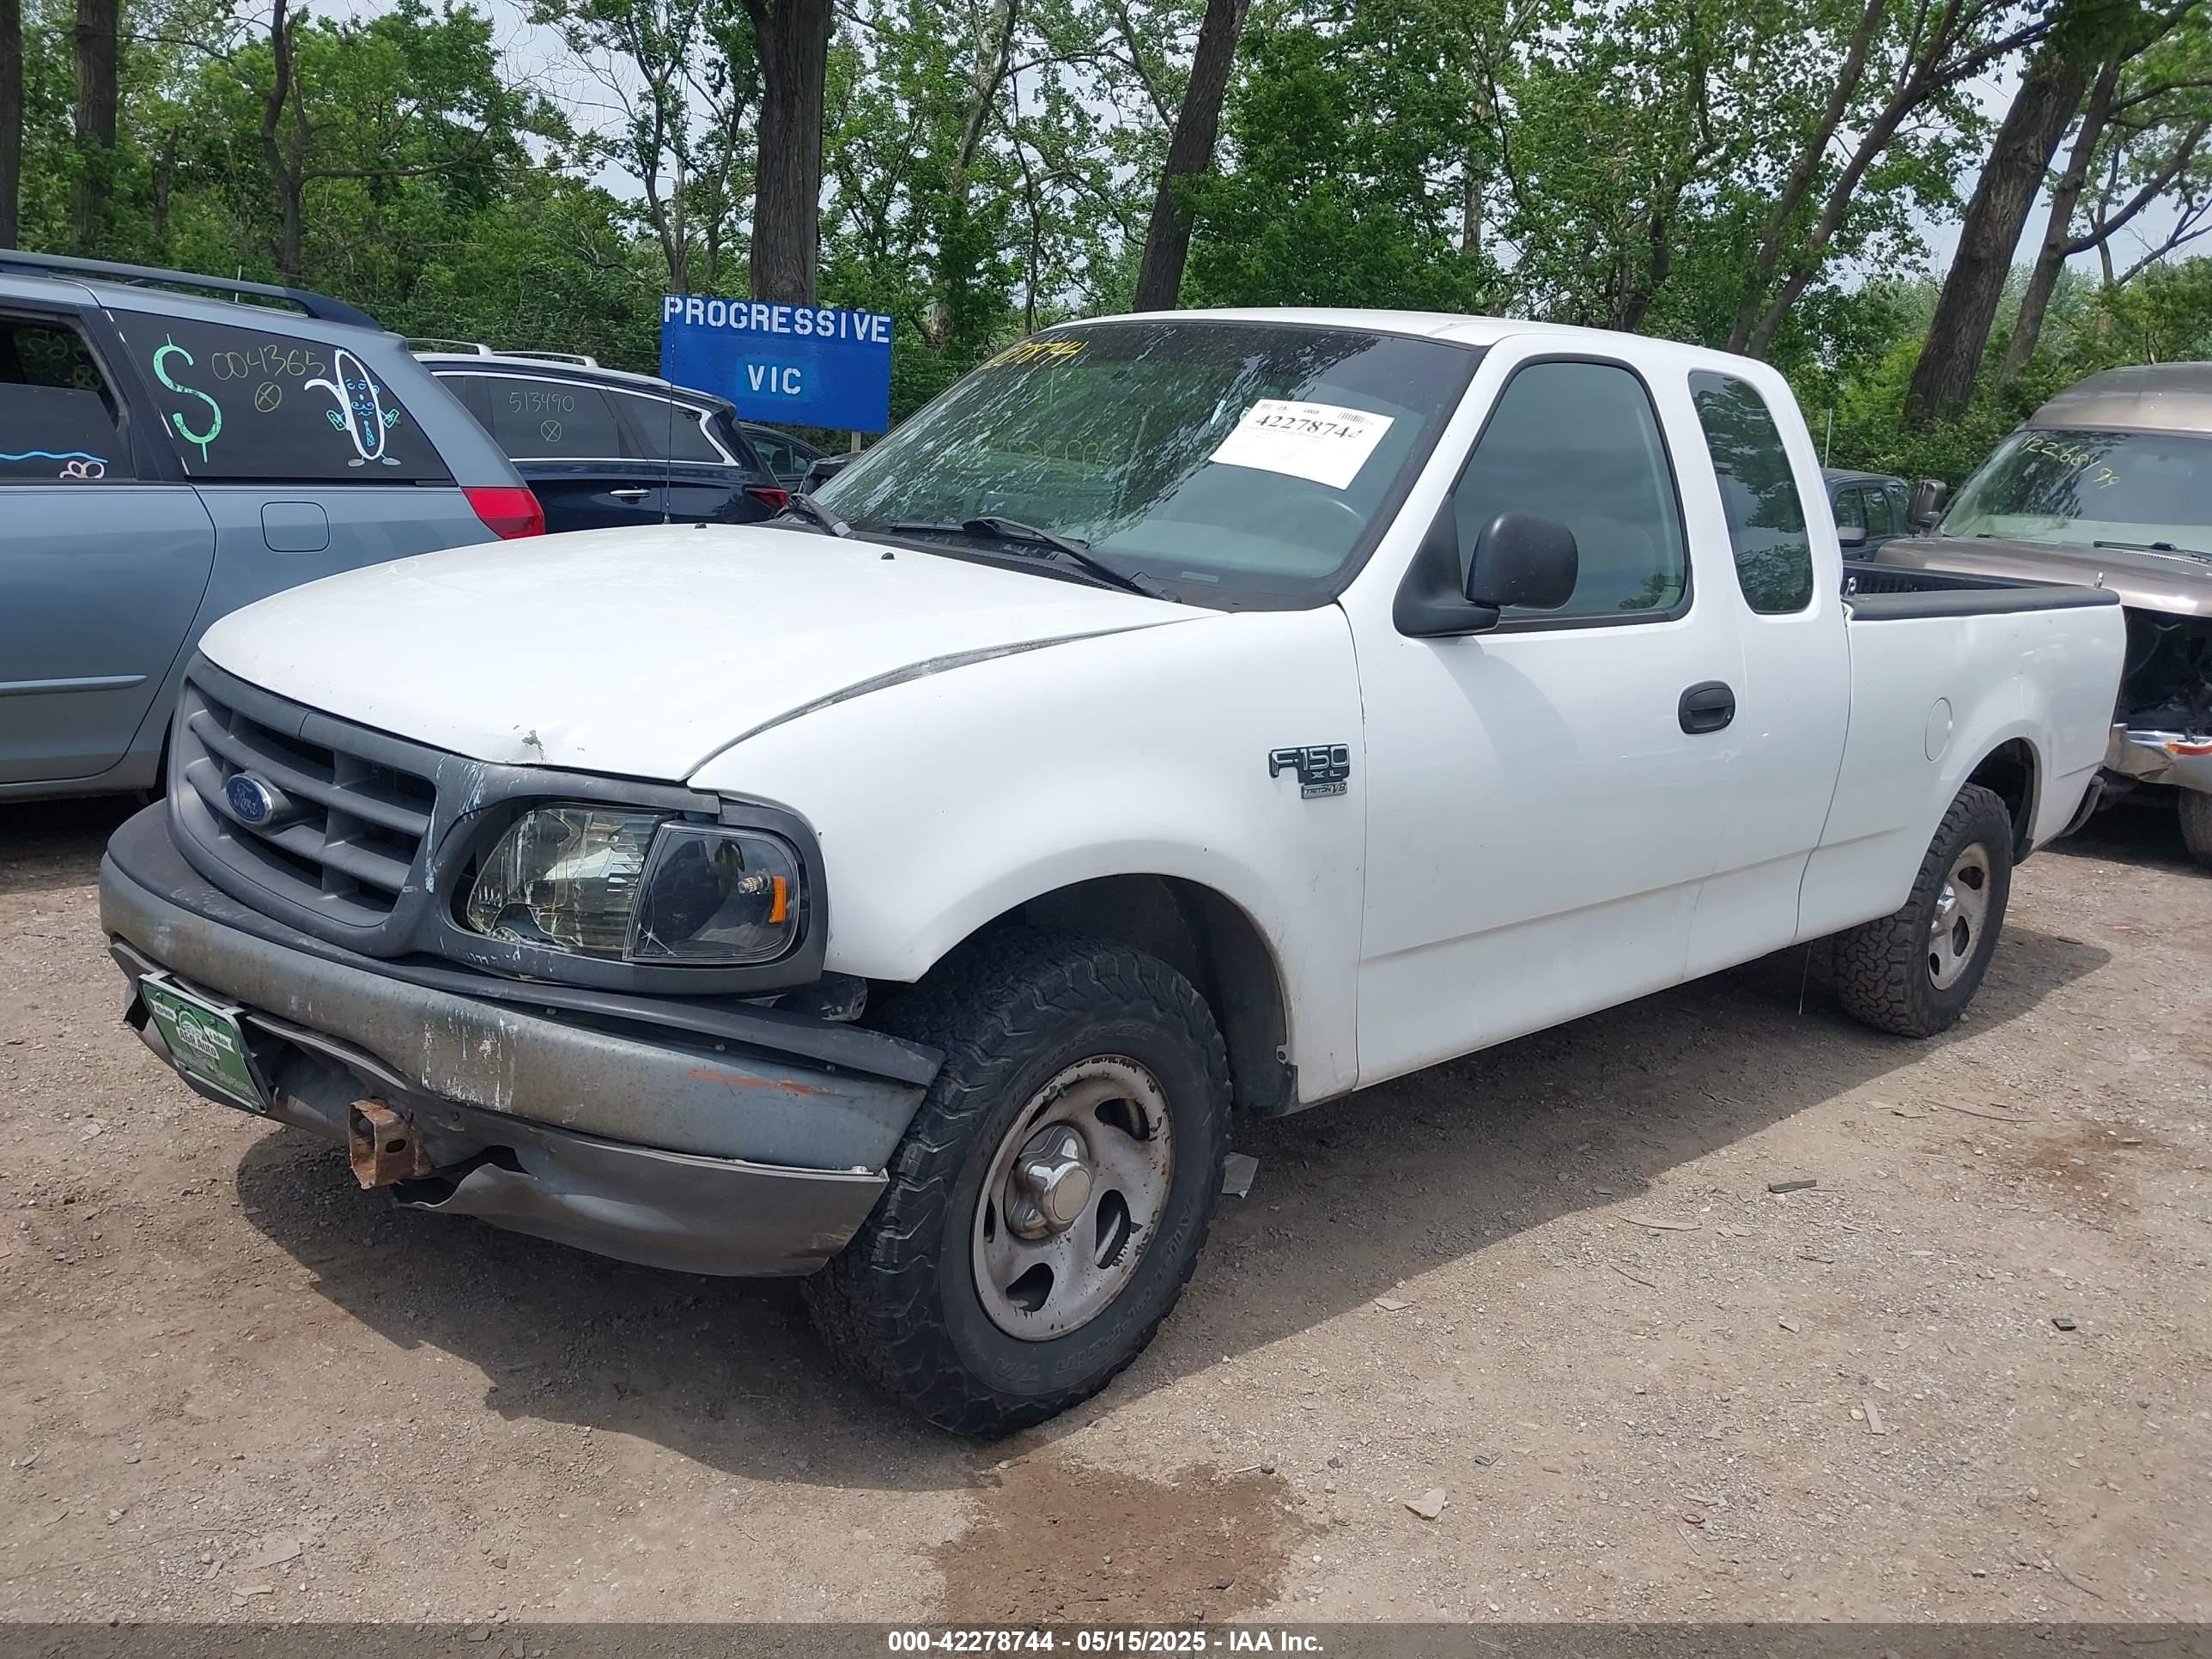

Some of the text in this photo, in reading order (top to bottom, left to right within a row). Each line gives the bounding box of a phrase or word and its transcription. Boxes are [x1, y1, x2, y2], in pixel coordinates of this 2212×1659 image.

[664, 295, 891, 343] PROGRESSIVE
[211, 344, 326, 380] 004365
[747, 364, 802, 395] VIC
[509, 392, 574, 412] 513490
[233, 782, 259, 816] Ford
[1305, 782, 1347, 795] TRITON V8
